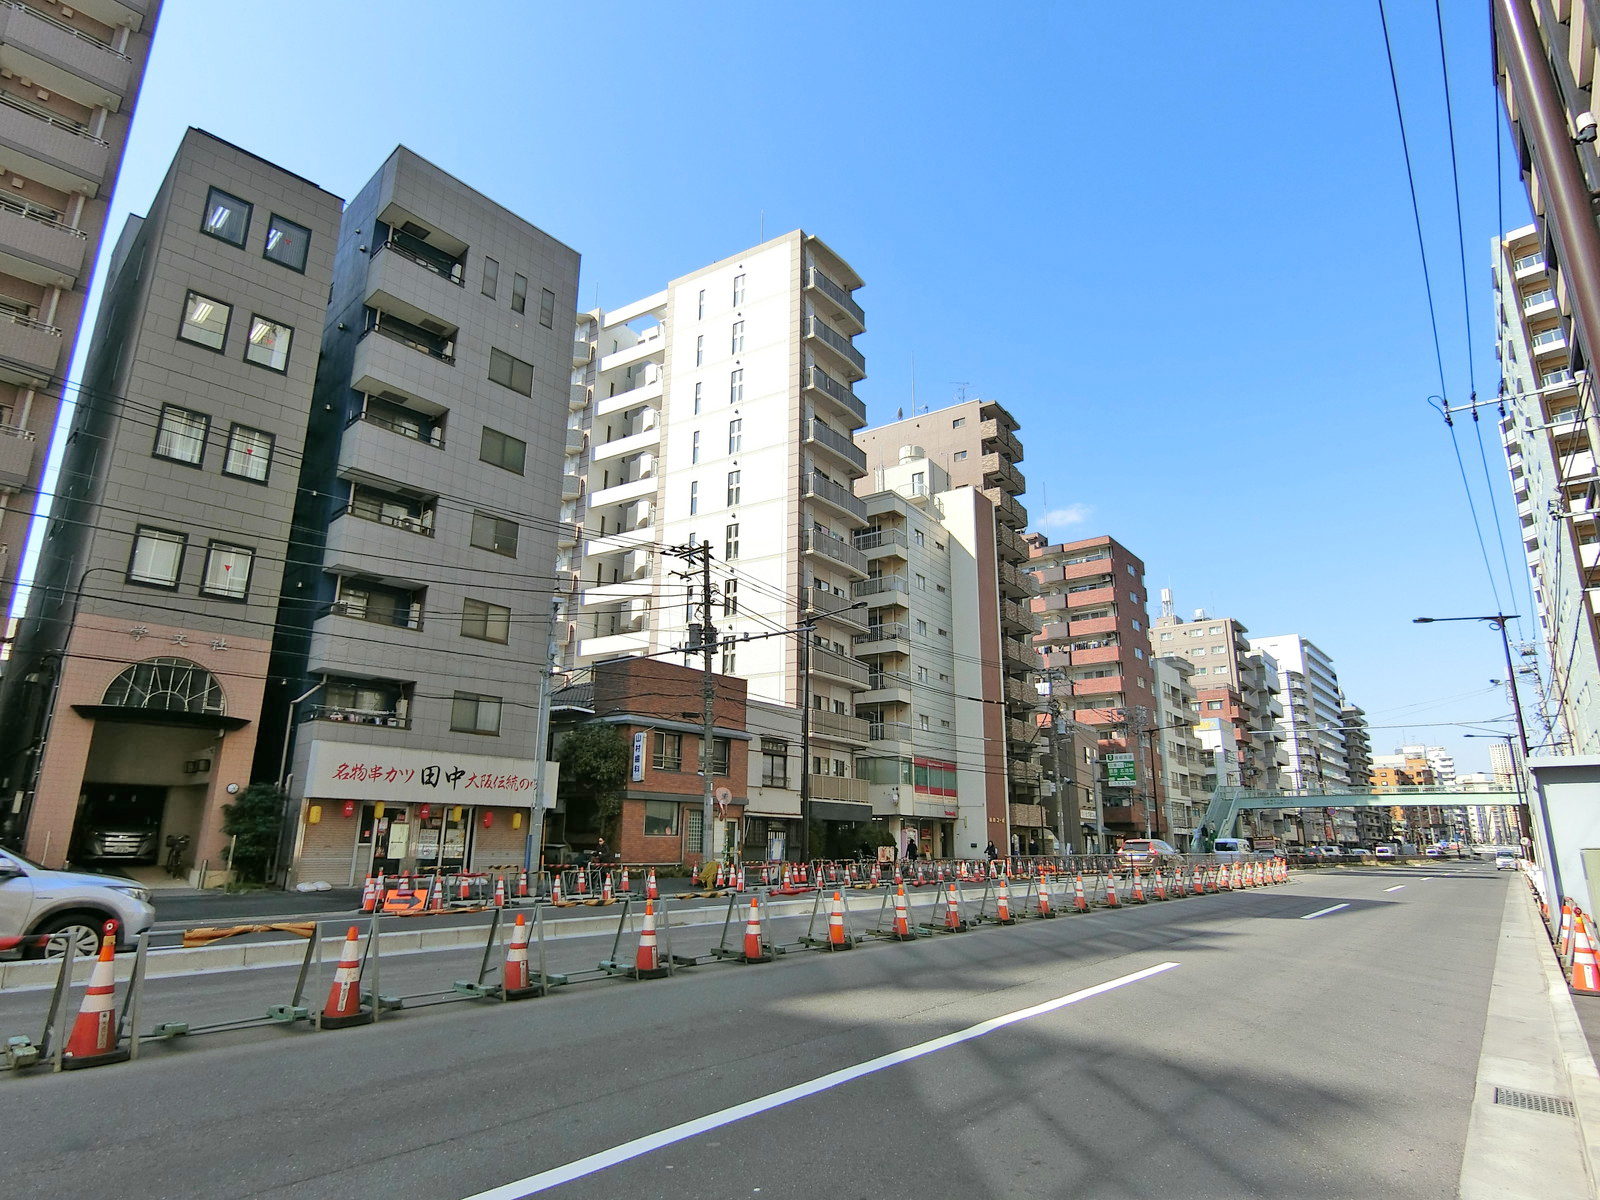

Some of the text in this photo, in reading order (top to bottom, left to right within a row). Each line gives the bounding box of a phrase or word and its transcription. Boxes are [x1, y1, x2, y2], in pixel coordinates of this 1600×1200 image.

[130, 625, 228, 651] 学文社
[332, 762, 415, 784] 名物串カツ
[421, 765, 466, 790] 田中
